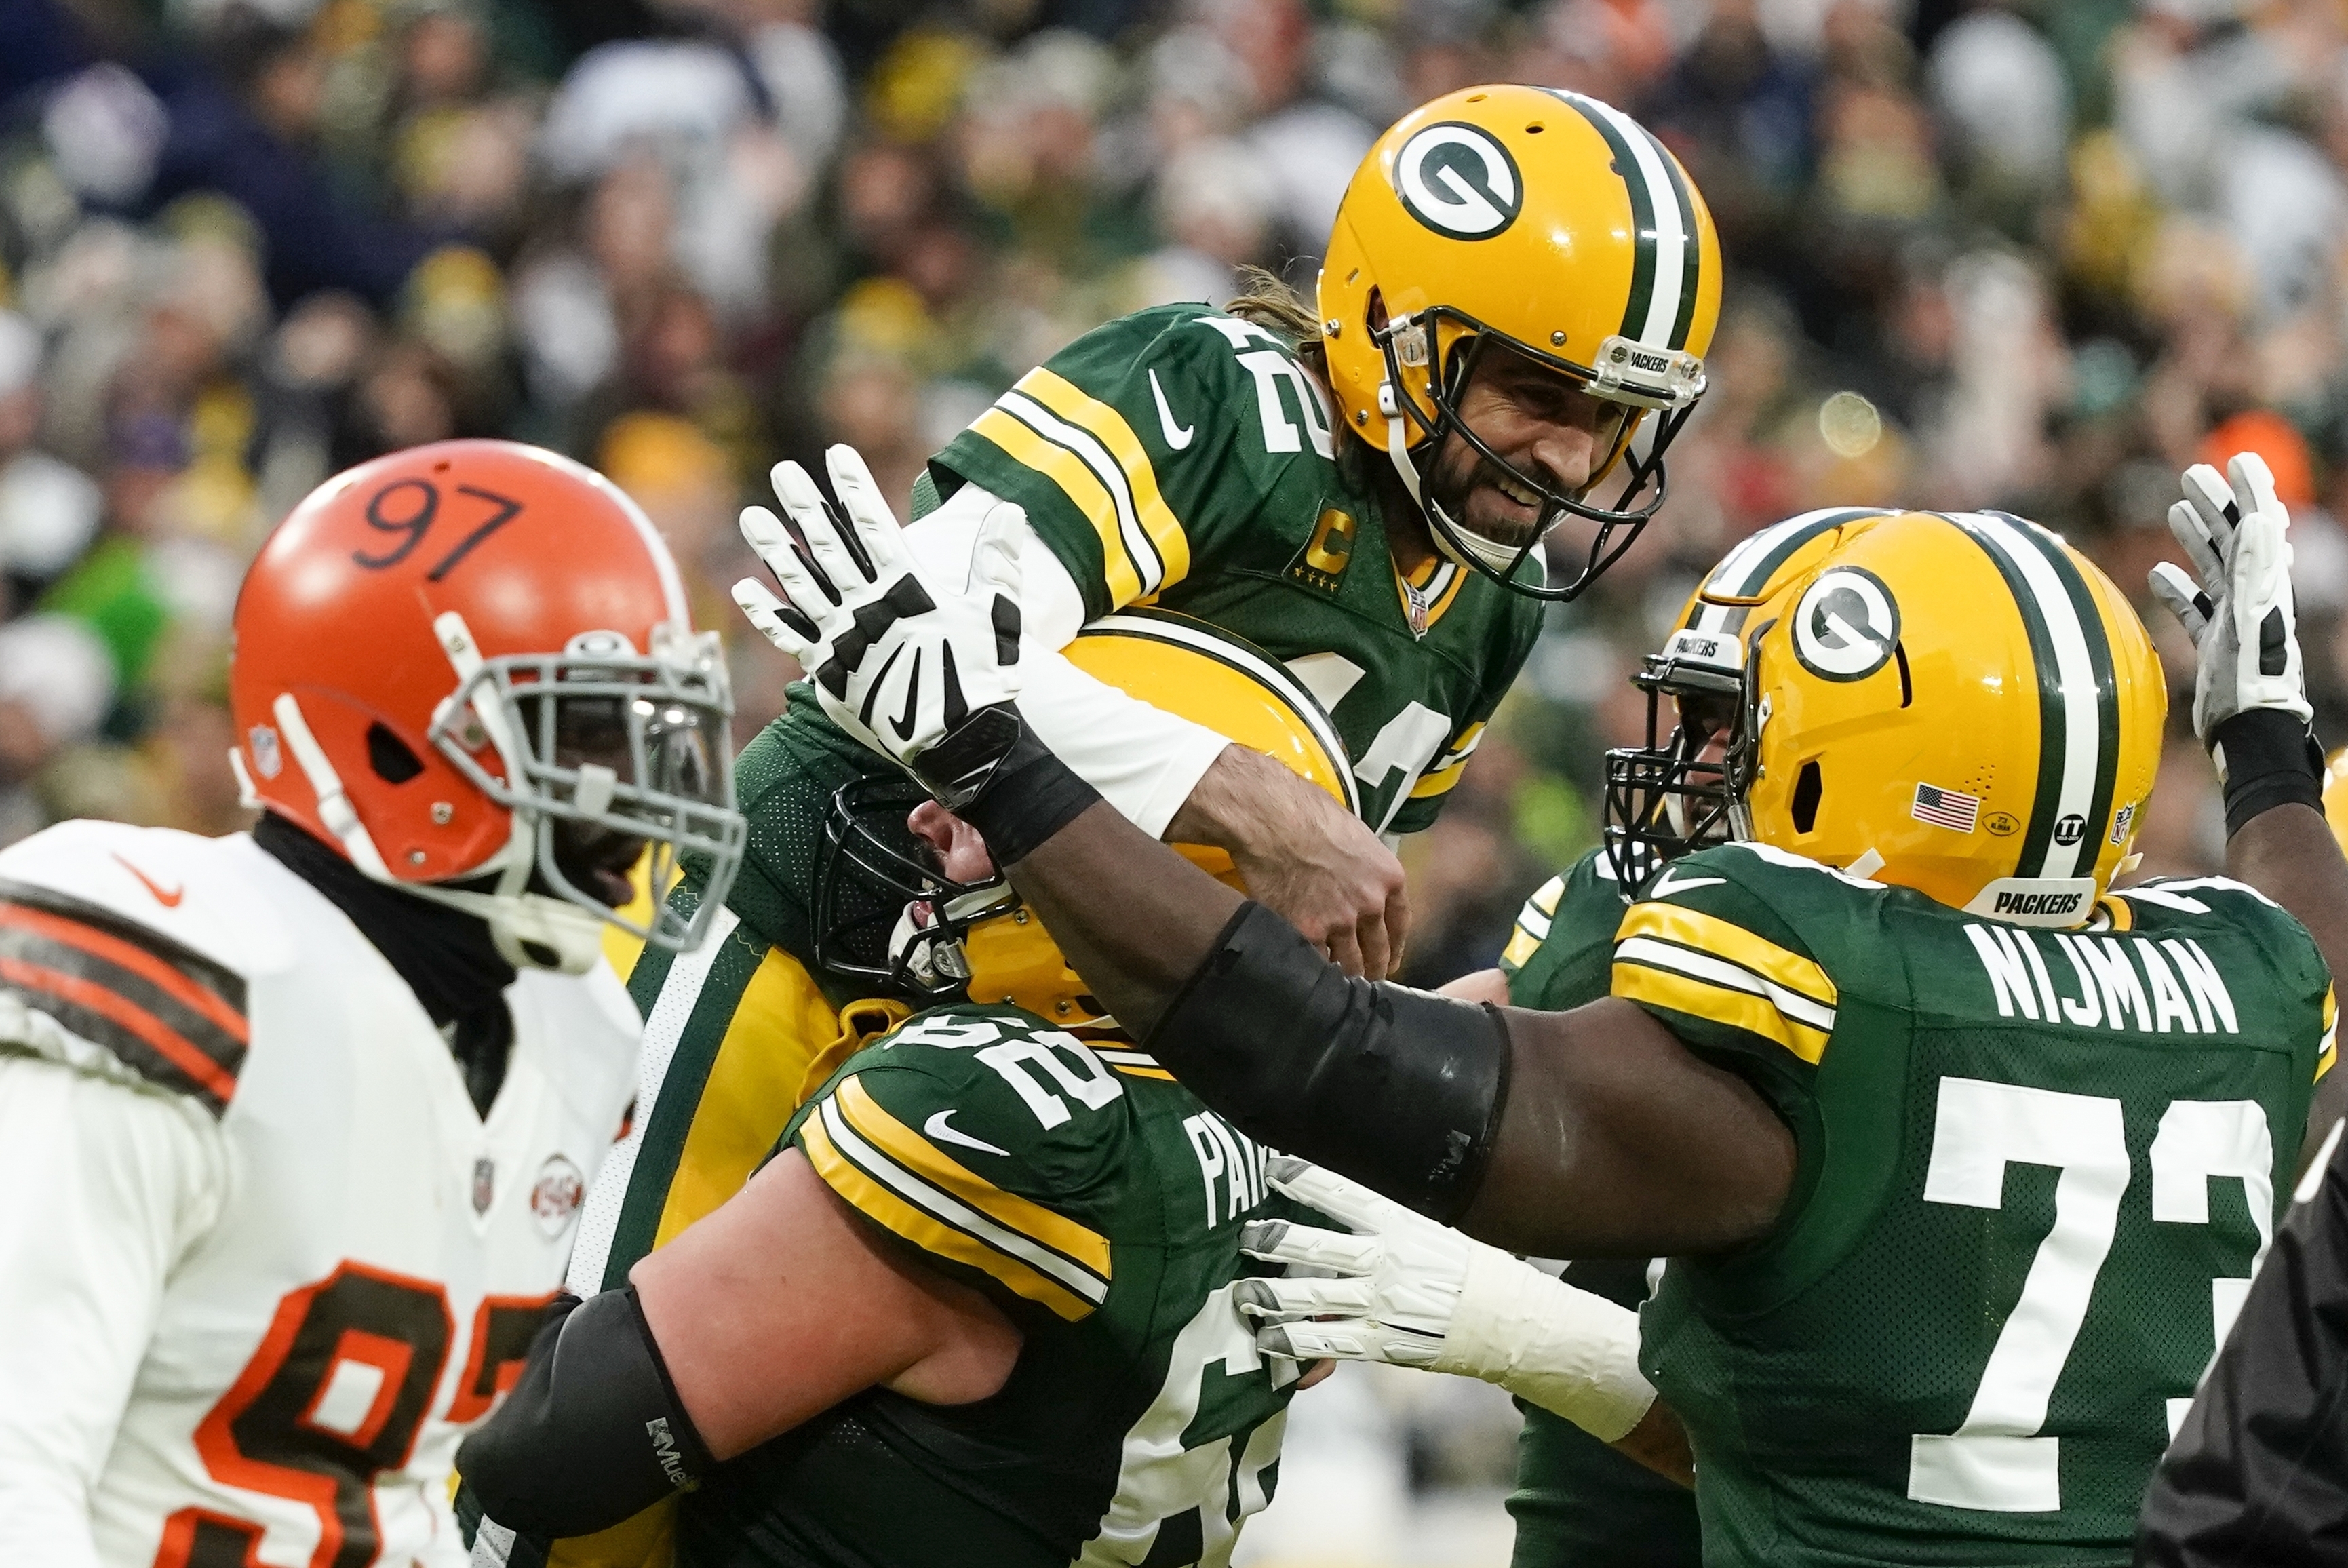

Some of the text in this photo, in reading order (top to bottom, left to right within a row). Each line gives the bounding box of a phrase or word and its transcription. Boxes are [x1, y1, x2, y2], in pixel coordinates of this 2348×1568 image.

[352, 477, 522, 583] 97
[1306, 508, 1356, 574] C
[1674, 637, 1719, 658] PACKERS
[2060, 819, 2083, 836] TT
[1994, 892, 2083, 914] PACKERS
[1964, 924, 2239, 1034] NIJMAN
